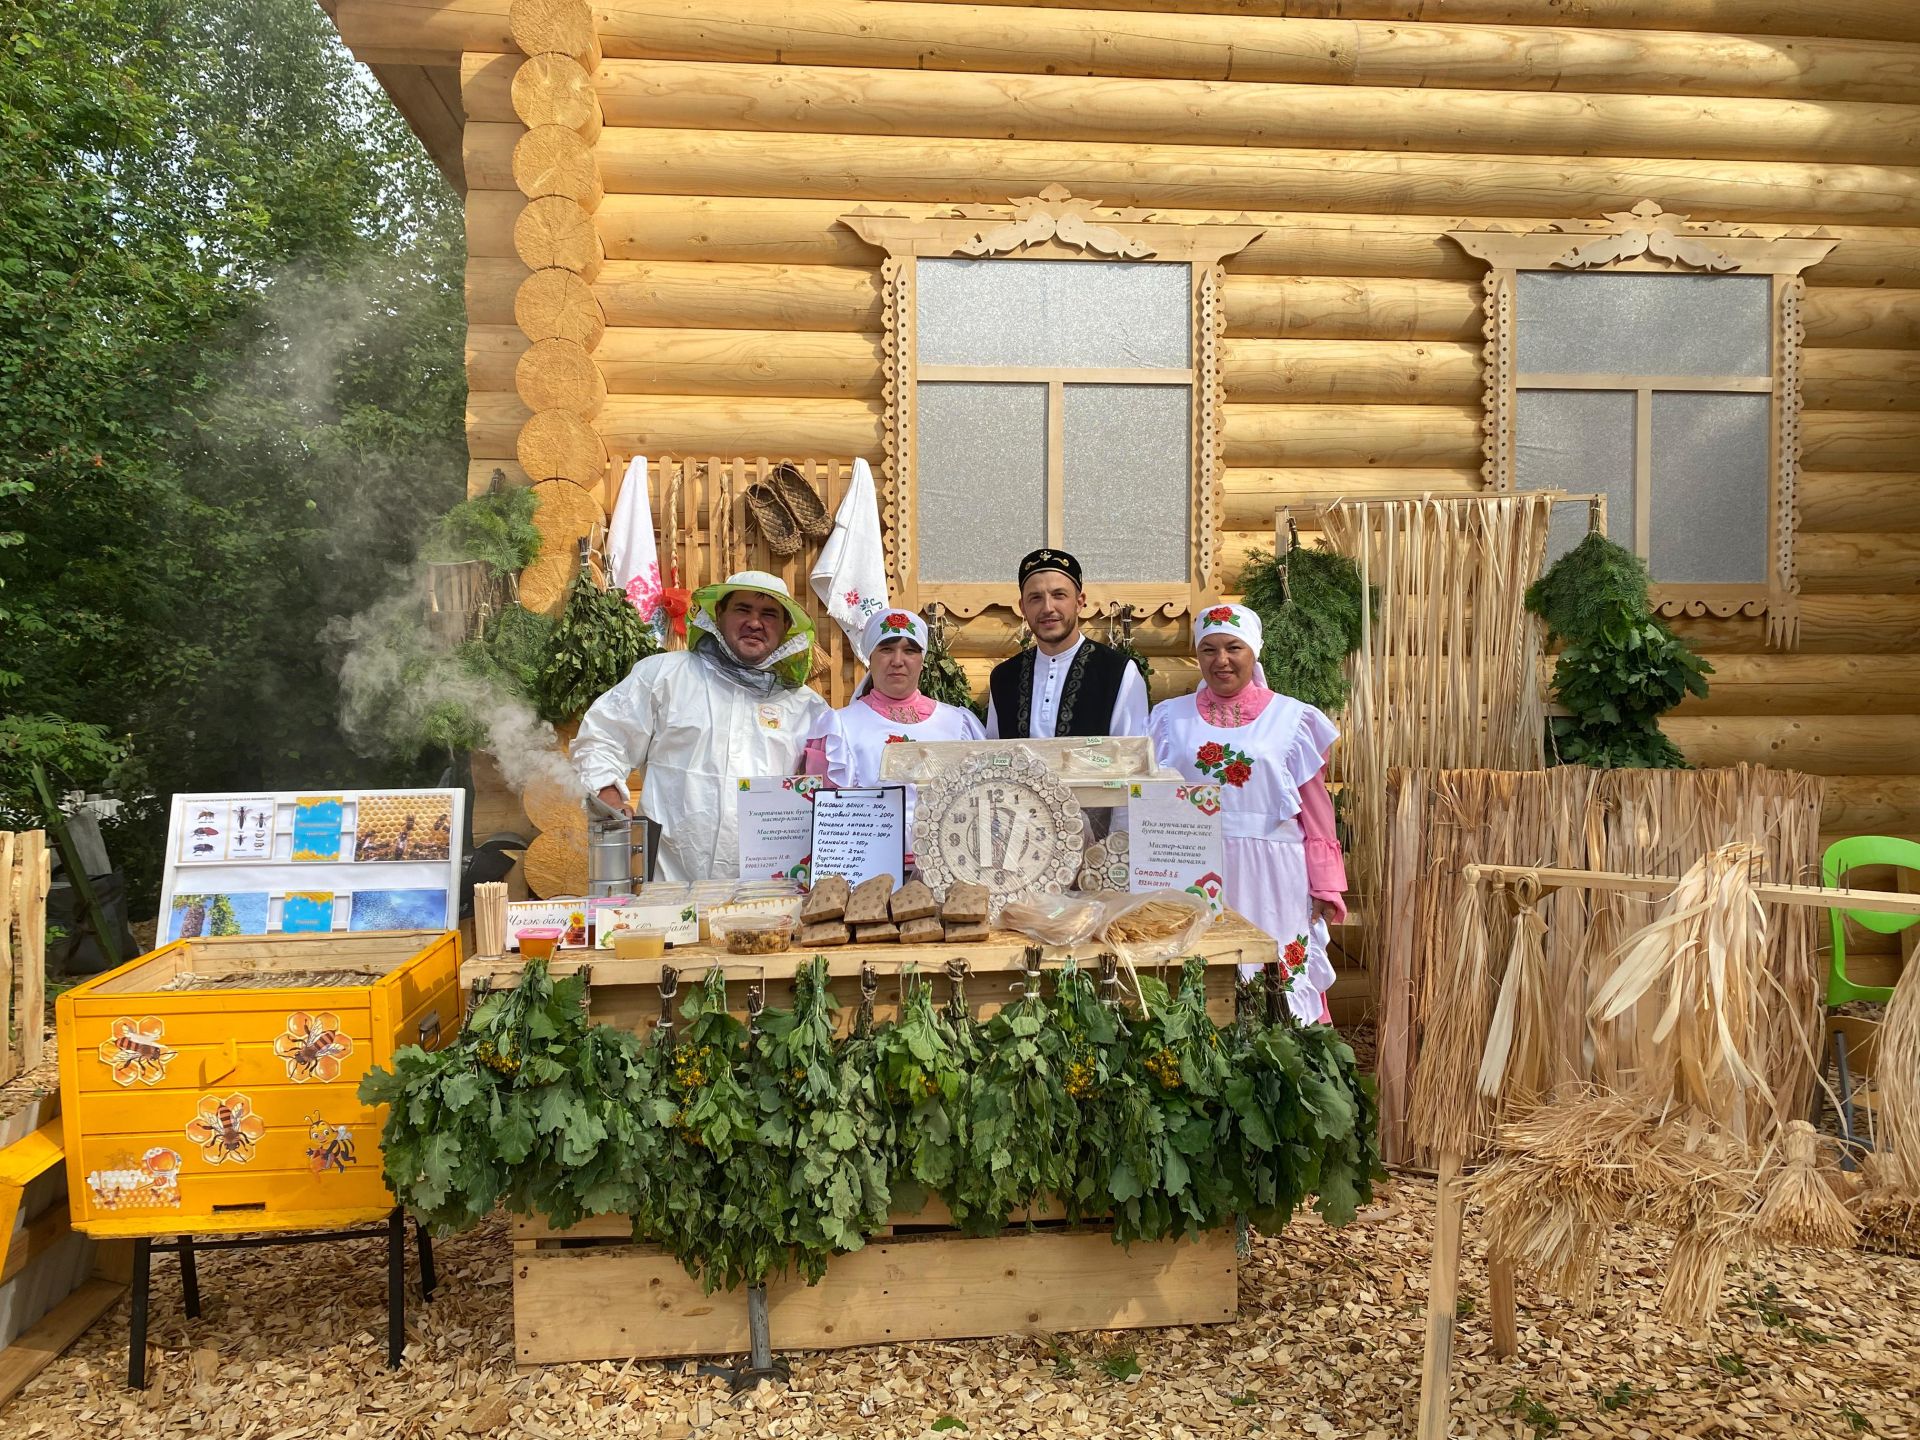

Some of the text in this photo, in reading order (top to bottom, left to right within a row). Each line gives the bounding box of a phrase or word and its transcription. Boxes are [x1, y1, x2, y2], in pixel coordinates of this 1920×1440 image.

[986, 789, 1004, 803] 12
[1014, 794, 1020, 804] 1
[952, 813, 967, 823] 10
[1028, 808, 1038, 818] 2
[1035, 827, 1046, 841] 3
[1141, 827, 1212, 837] буенча мастер-класс
[949, 833, 961, 847] 9
[1148, 841, 1196, 850] Мастер-класс
[1031, 850, 1040, 860] 4
[1152, 850, 1201, 858] изготовлению
[957, 854, 967, 865] 8
